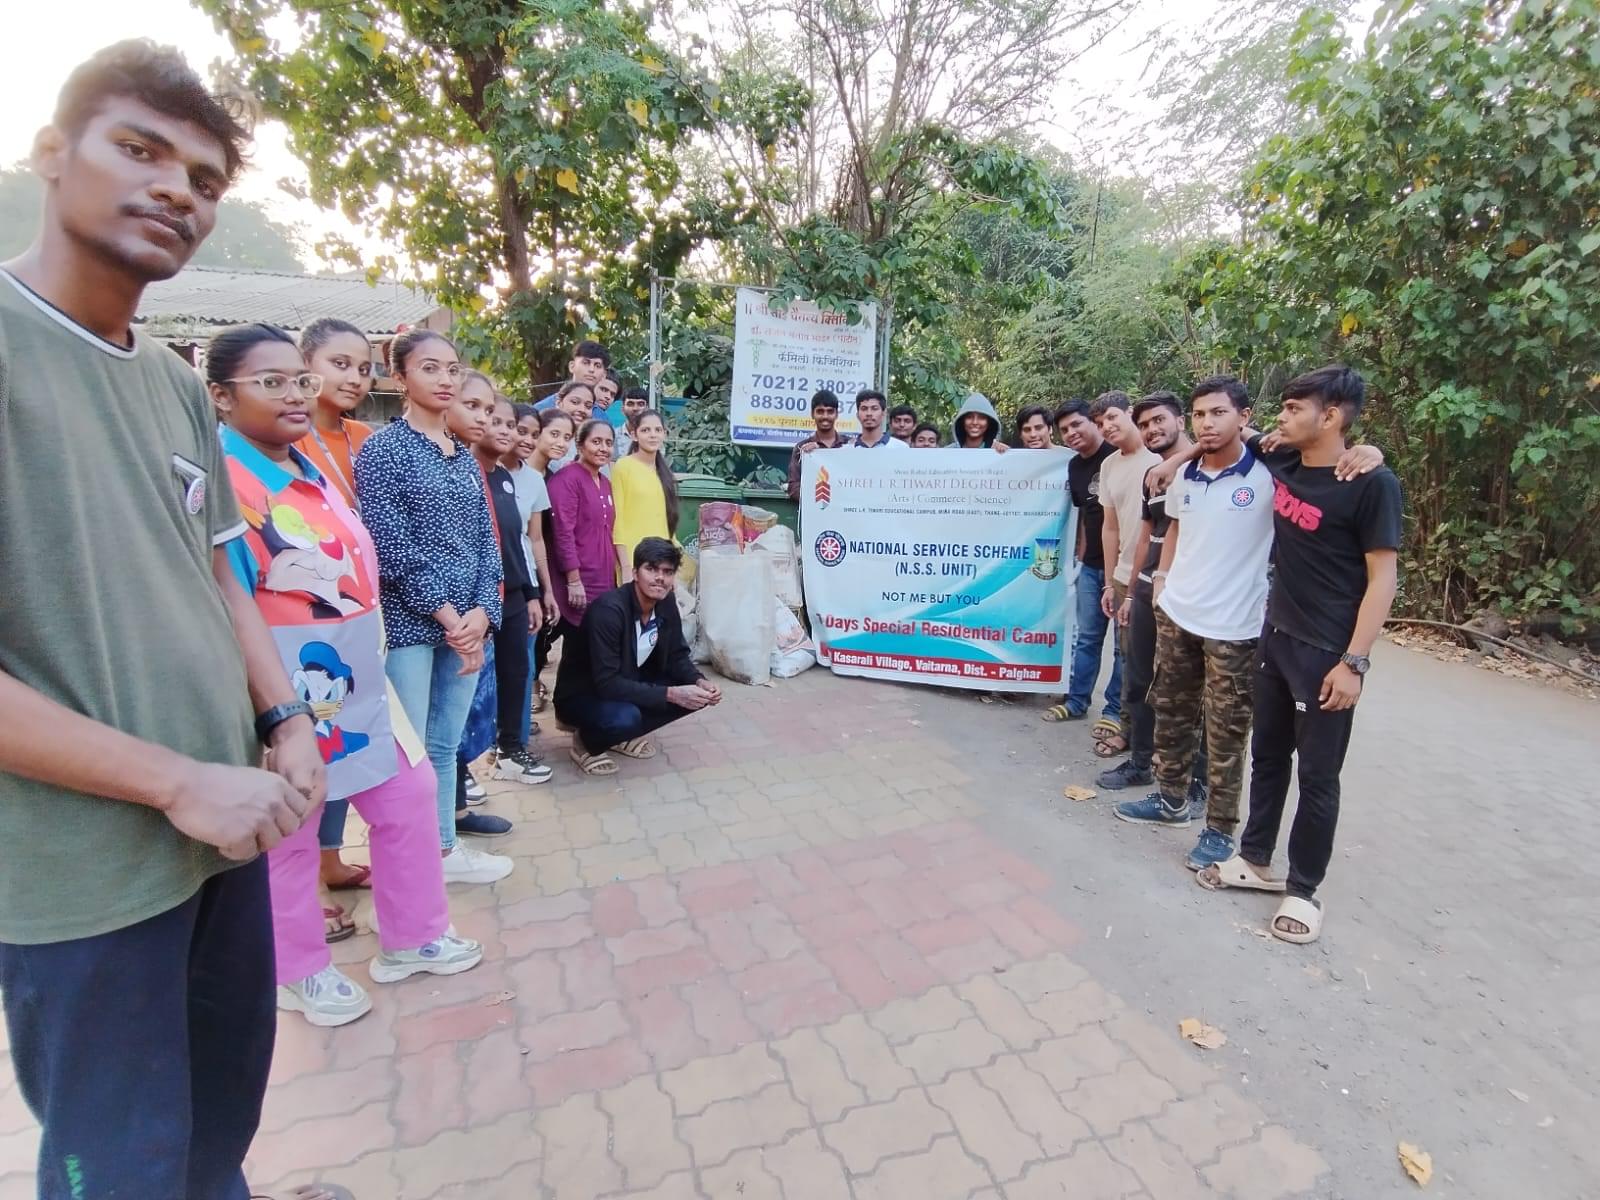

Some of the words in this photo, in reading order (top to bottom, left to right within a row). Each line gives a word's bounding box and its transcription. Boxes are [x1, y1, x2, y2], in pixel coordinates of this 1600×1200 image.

[751, 373, 808, 391] 70212
[750, 394, 807, 411] 88300
[902, 478, 946, 489] TIWARI
[950, 478, 1001, 491] DEGREE
[849, 540, 908, 556] NATIONAL
[913, 543, 969, 558] SERVICE
[974, 544, 1030, 560] SCHEME
[895, 561, 936, 577] (N.S.S.
[941, 562, 977, 580] UNIT)
[882, 591, 906, 602] NOT
[909, 593, 929, 603] ME
[930, 594, 952, 604] BUT
[955, 594, 980, 606] YOU
[825, 614, 859, 633] Days
[863, 617, 915, 636] Special
[921, 621, 1006, 642] Residential
[1012, 627, 1057, 649] Camp
[833, 651, 873, 666] Kasarali
[875, 655, 913, 671] Village,
[915, 659, 961, 675] Vaitarna,
[963, 663, 988, 677] Dist.
[998, 667, 1041, 681] Palghar
